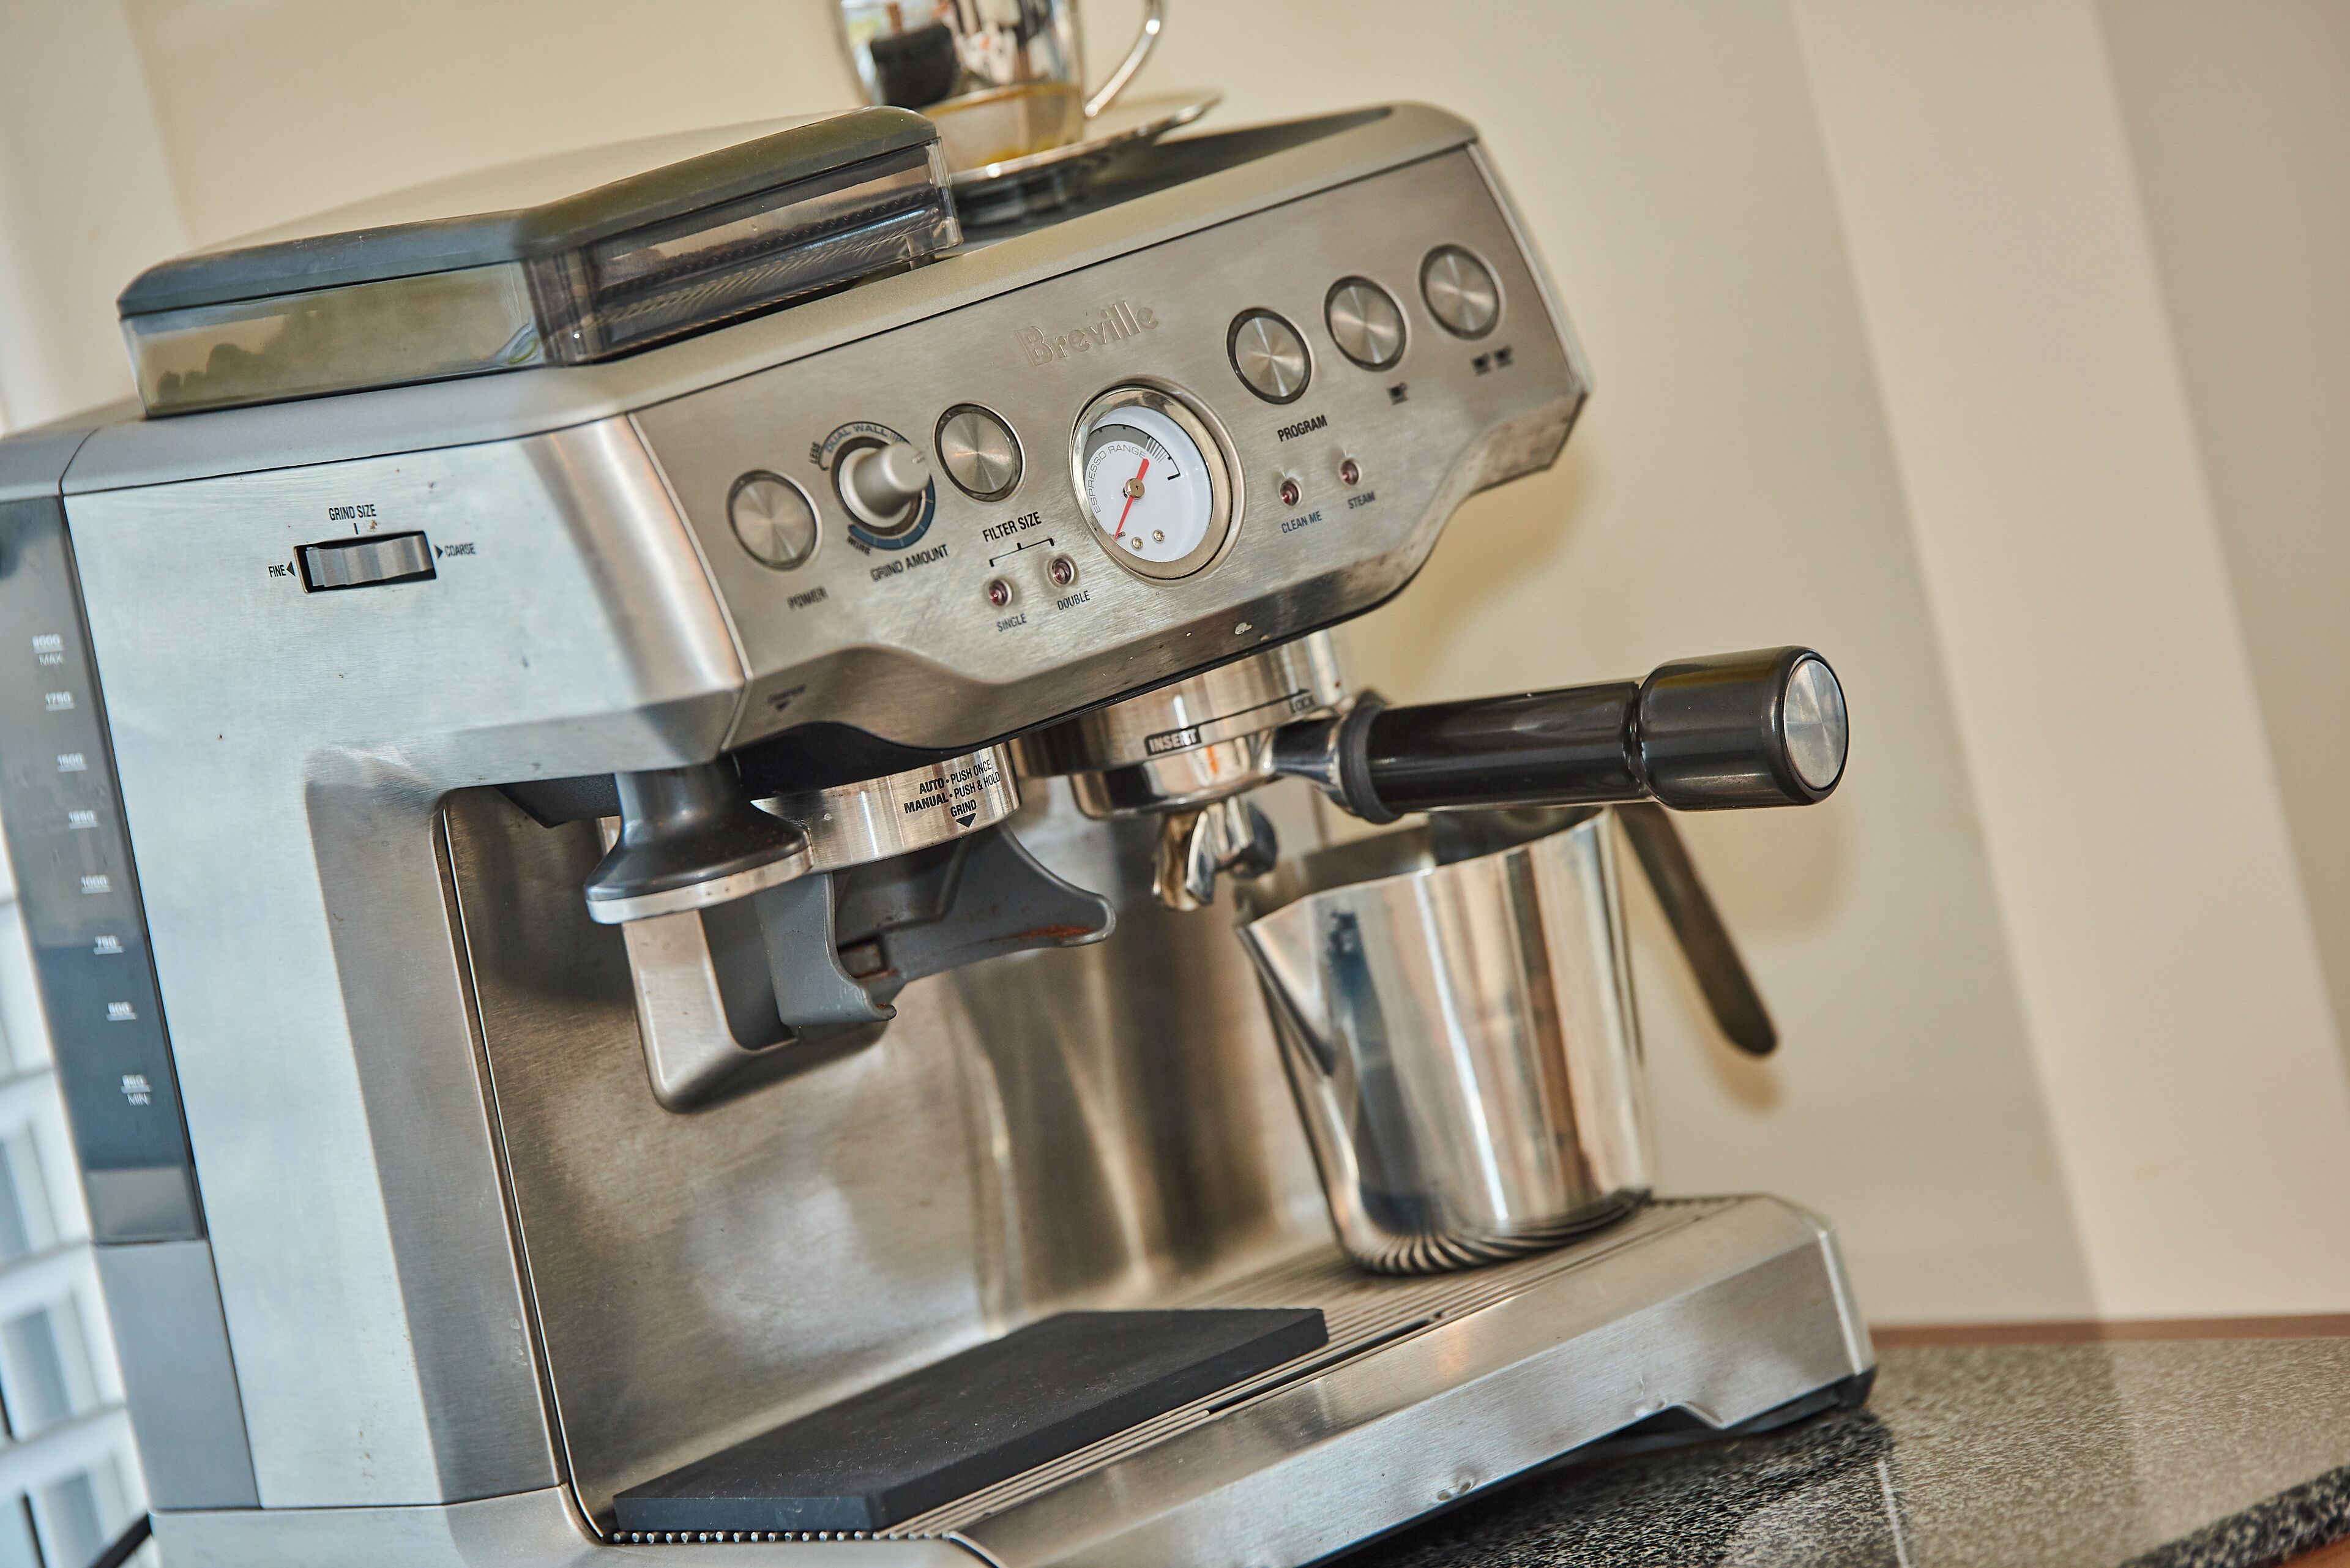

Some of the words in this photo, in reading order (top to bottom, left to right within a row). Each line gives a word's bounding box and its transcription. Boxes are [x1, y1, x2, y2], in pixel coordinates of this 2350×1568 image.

[1015, 300, 1159, 367] Breville
[826, 428, 851, 454] DUAL
[852, 424, 889, 438] WALL
[1277, 414, 1327, 442] PROGRAM
[1087, 450, 1106, 513] ESPRESSO
[1108, 444, 1146, 460] RANGE
[1348, 491, 1376, 509] STEAM
[329, 506, 355, 521] GRIND
[357, 504, 376, 518] SIZE
[1281, 515, 1308, 534] CLEAN
[1308, 510, 1322, 524] ME
[982, 521, 1018, 542] FILTER
[1018, 512, 1042, 530] SIZE
[444, 543, 476, 557] COARSE
[268, 564, 286, 578] FINE
[870, 562, 903, 581] GRIND
[905, 544, 949, 569] AMOUNT
[787, 586, 829, 610] POWER
[1057, 590, 1091, 611] DOUBLE
[996, 613, 1027, 632] SINGLE
[39, 652, 63, 666] MAX
[1149, 730, 1198, 752] INSERT
[919, 777, 945, 794] AUTO
[950, 766, 973, 785] PUSH
[973, 759, 992, 776] ONCE
[904, 792, 949, 814] MANUAL
[954, 781, 976, 799] PUSH
[977, 780, 983, 790] &
[984, 771, 1001, 789] HOLD
[950, 799, 977, 817] GRIND
[127, 1092, 149, 1105] MIN
